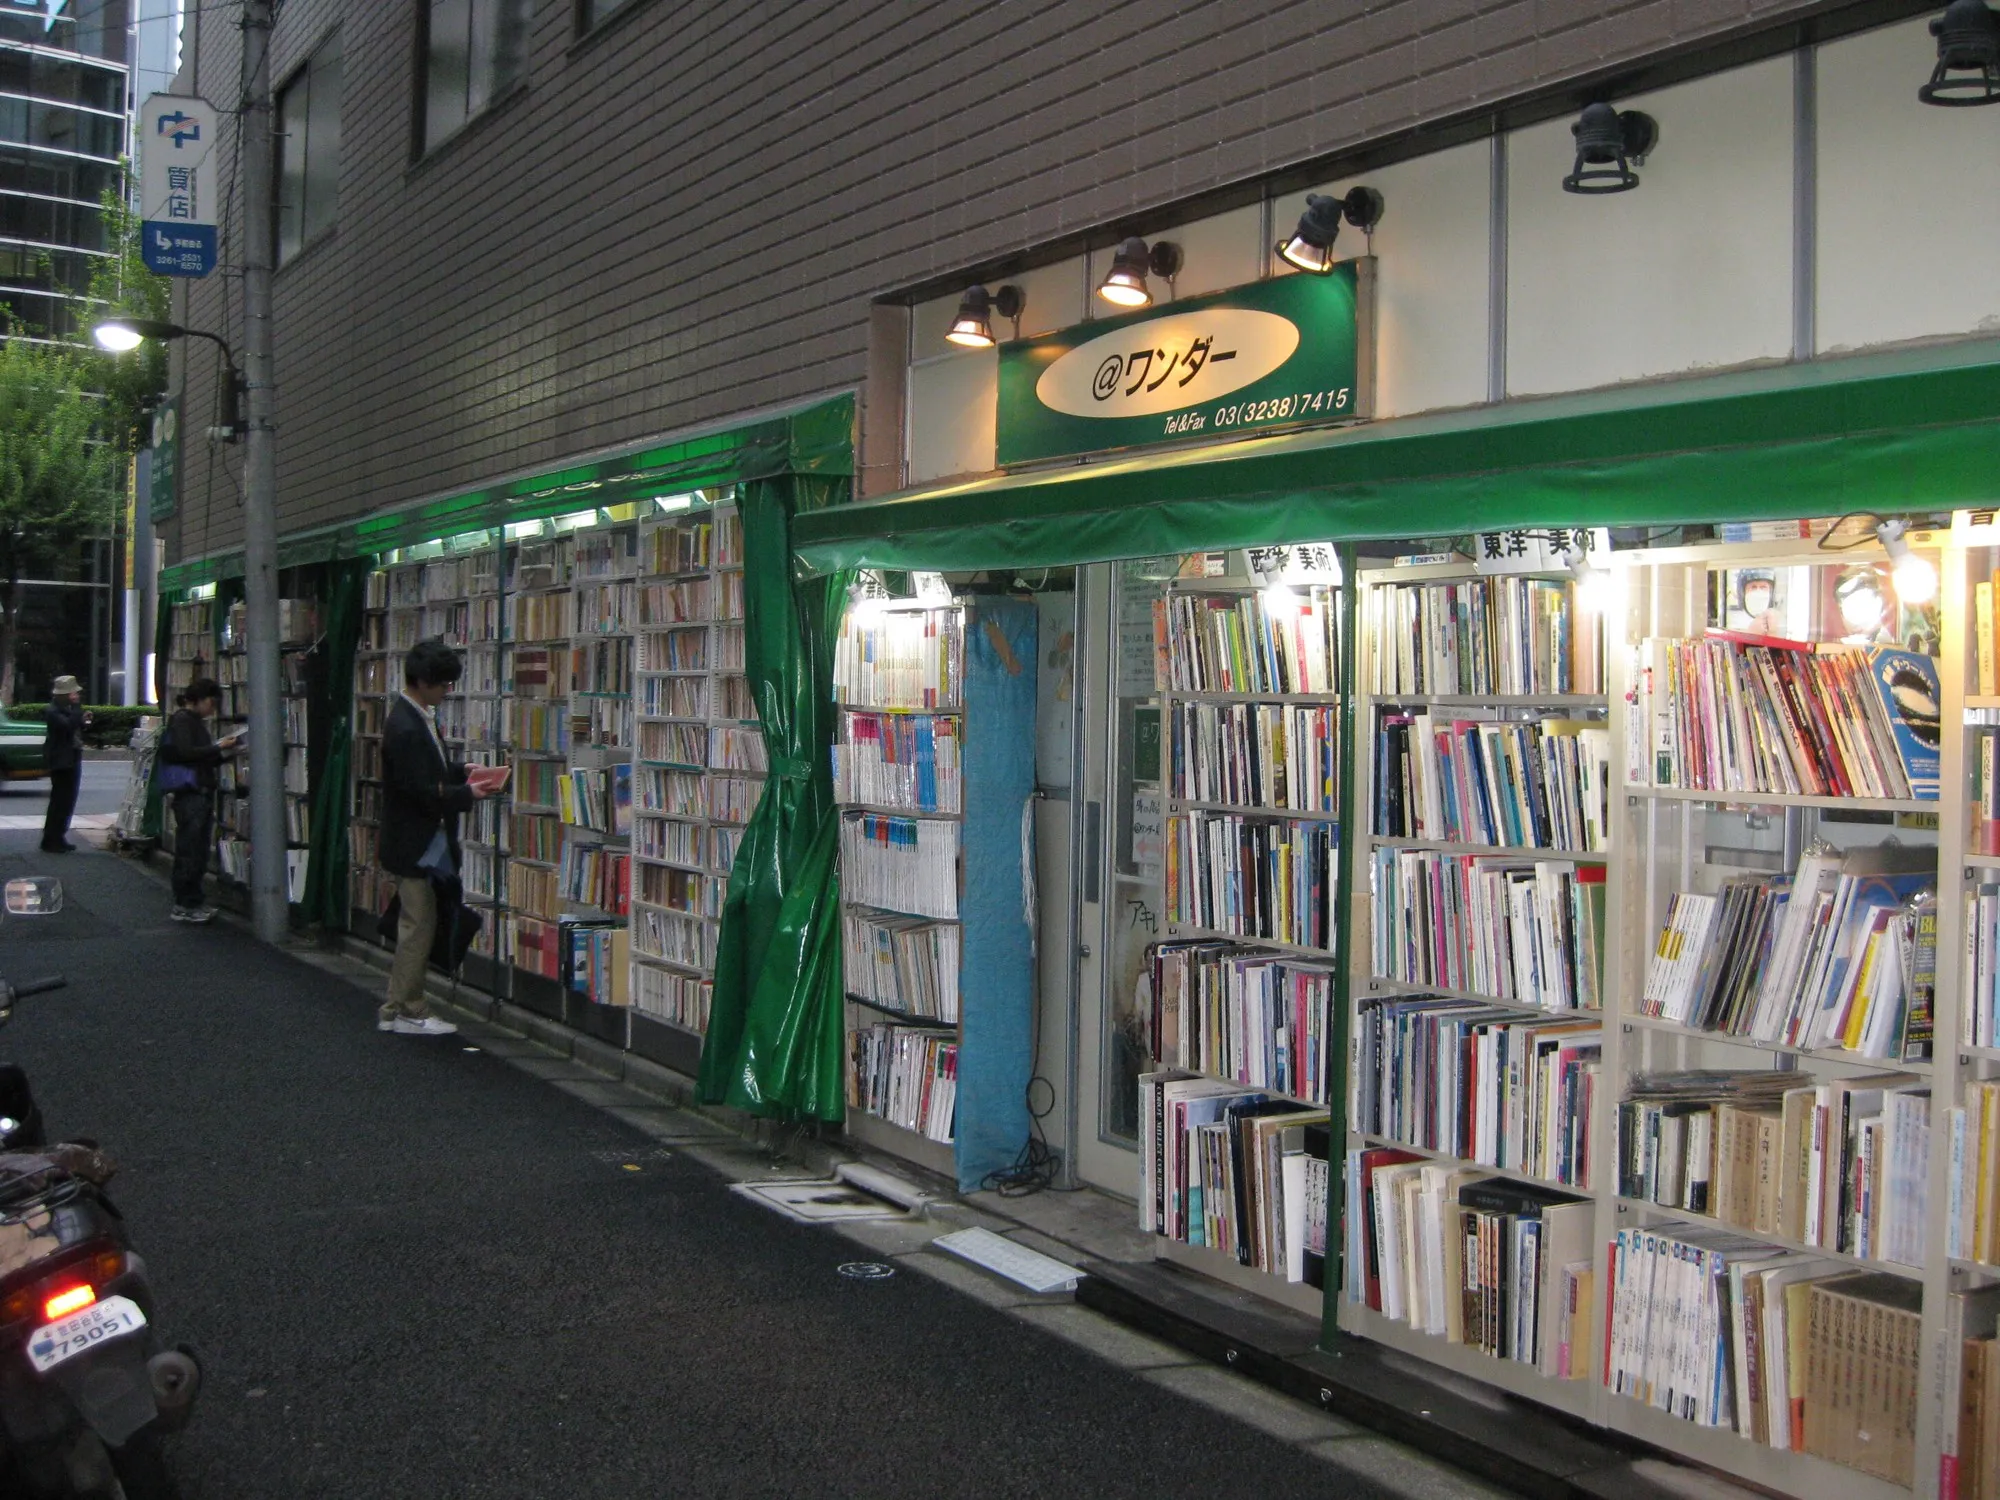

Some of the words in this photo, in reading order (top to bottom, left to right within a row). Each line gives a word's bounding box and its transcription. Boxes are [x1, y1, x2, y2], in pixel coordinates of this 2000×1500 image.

[168, 166, 190, 219] 質店
[1092, 335, 1238, 401] @ワンダー
[1163, 411, 1207, 435] Tel&Fax
[1214, 387, 1349, 428] 03(3238)7415
[1297, 545, 1332, 571] 美術
[55, 1312, 132, 1355] 79051
